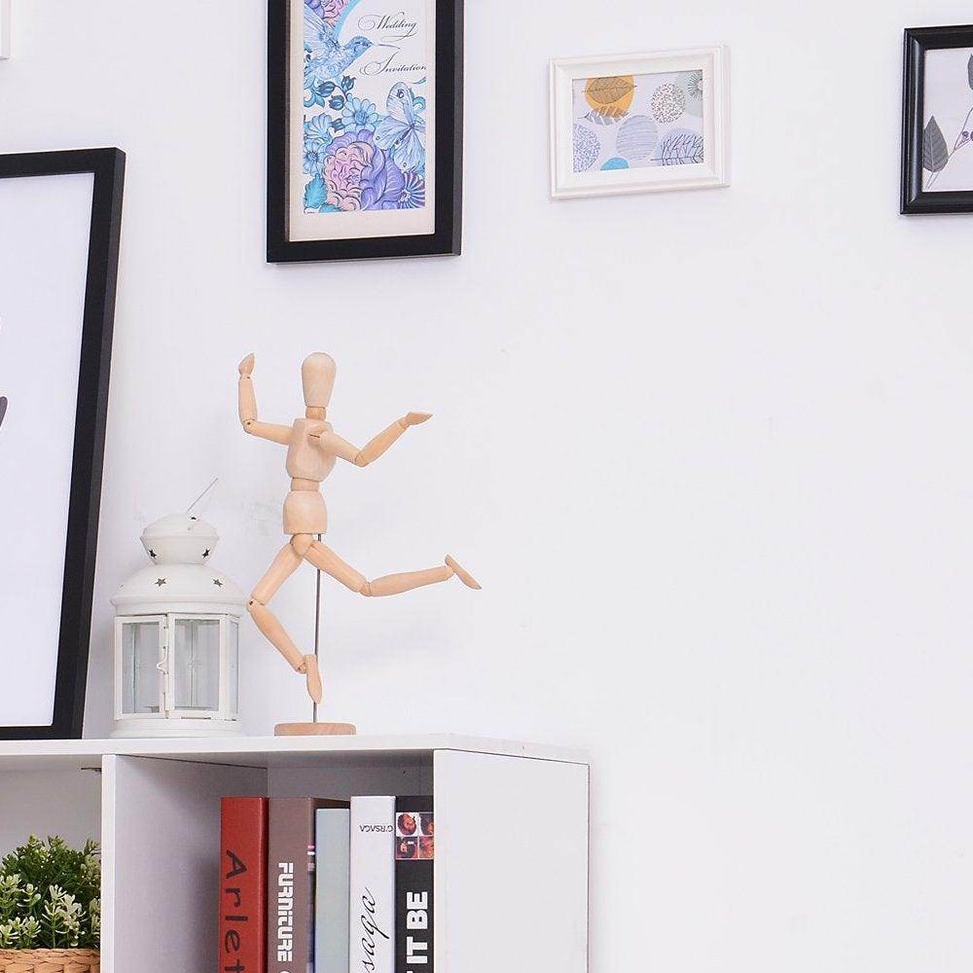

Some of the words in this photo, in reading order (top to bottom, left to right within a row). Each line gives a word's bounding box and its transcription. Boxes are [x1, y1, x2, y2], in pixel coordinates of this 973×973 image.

[358, 12, 418, 42] Wedding
[360, 52, 427, 75] Invitation
[406, 892, 428, 930] BE
[406, 936, 428, 964] IT
